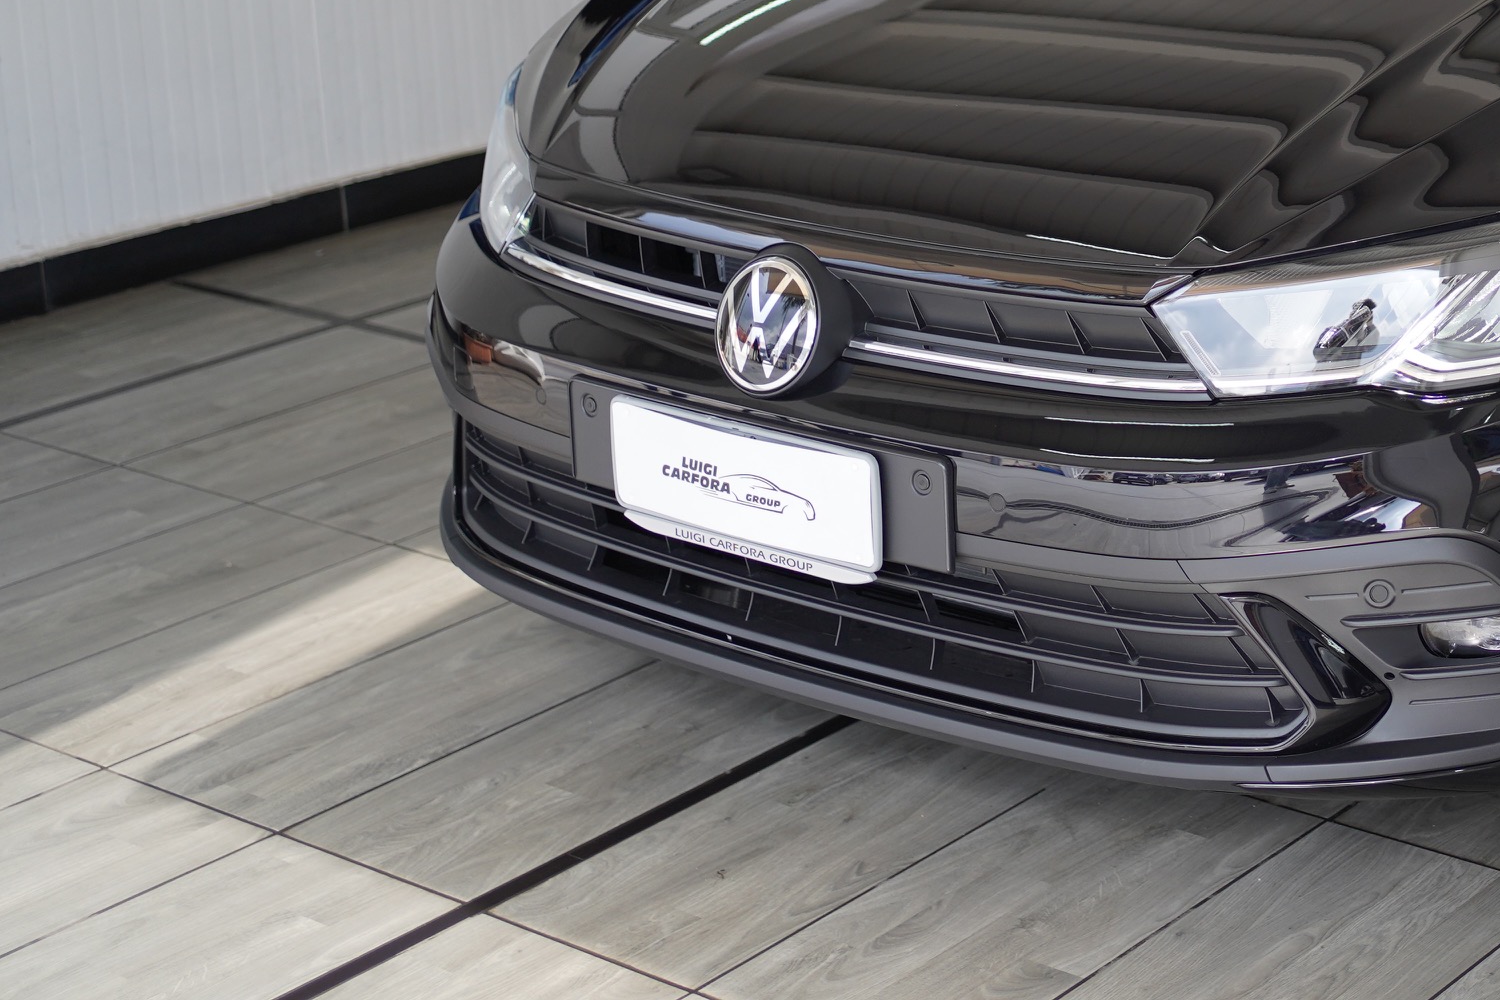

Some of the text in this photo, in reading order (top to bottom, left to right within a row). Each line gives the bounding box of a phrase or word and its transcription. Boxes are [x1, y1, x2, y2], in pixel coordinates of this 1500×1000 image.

[662, 464, 781, 508] CARFORA GROUP
[681, 456, 718, 477] LUIGI
[675, 527, 813, 573] LUIGI CARFORA GROUP
